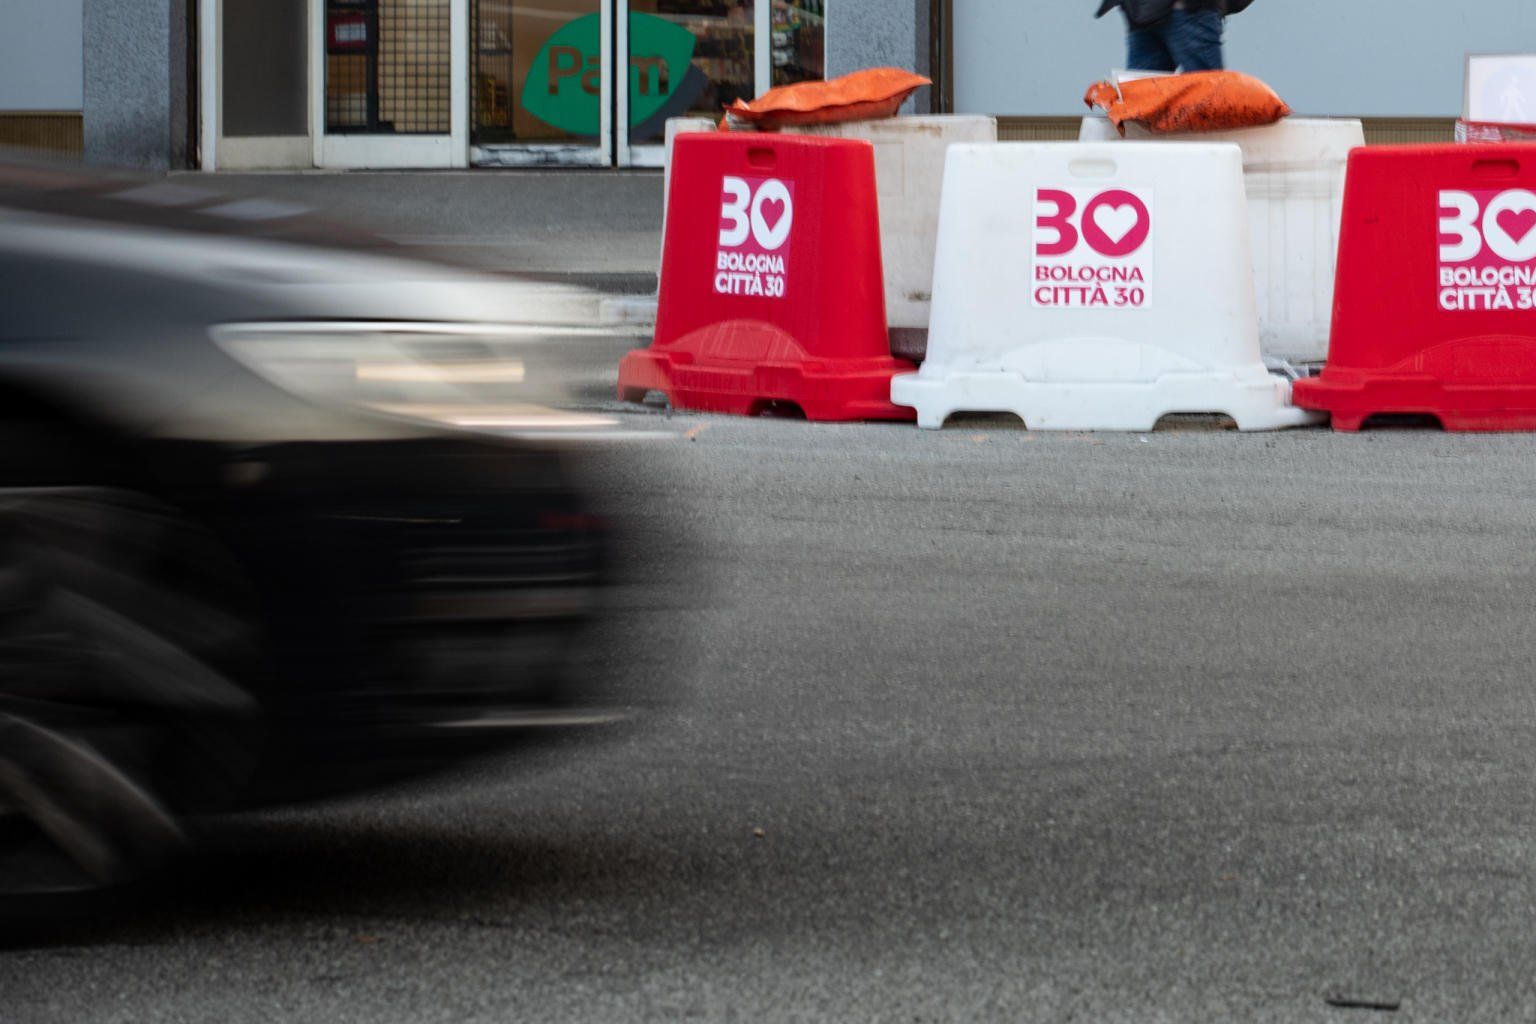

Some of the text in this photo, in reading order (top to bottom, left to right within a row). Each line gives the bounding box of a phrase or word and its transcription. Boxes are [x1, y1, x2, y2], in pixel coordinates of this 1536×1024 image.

[719, 175, 793, 250] 30
[1036, 188, 1150, 257] 30
[717, 251, 785, 274] BOLOGNA
[1035, 265, 1144, 282] BOLOGNA
[715, 269, 784, 298] CITTÀ 30
[1034, 281, 1144, 306] CITTÀ 30
[1439, 283, 1514, 310] CITTÀ
